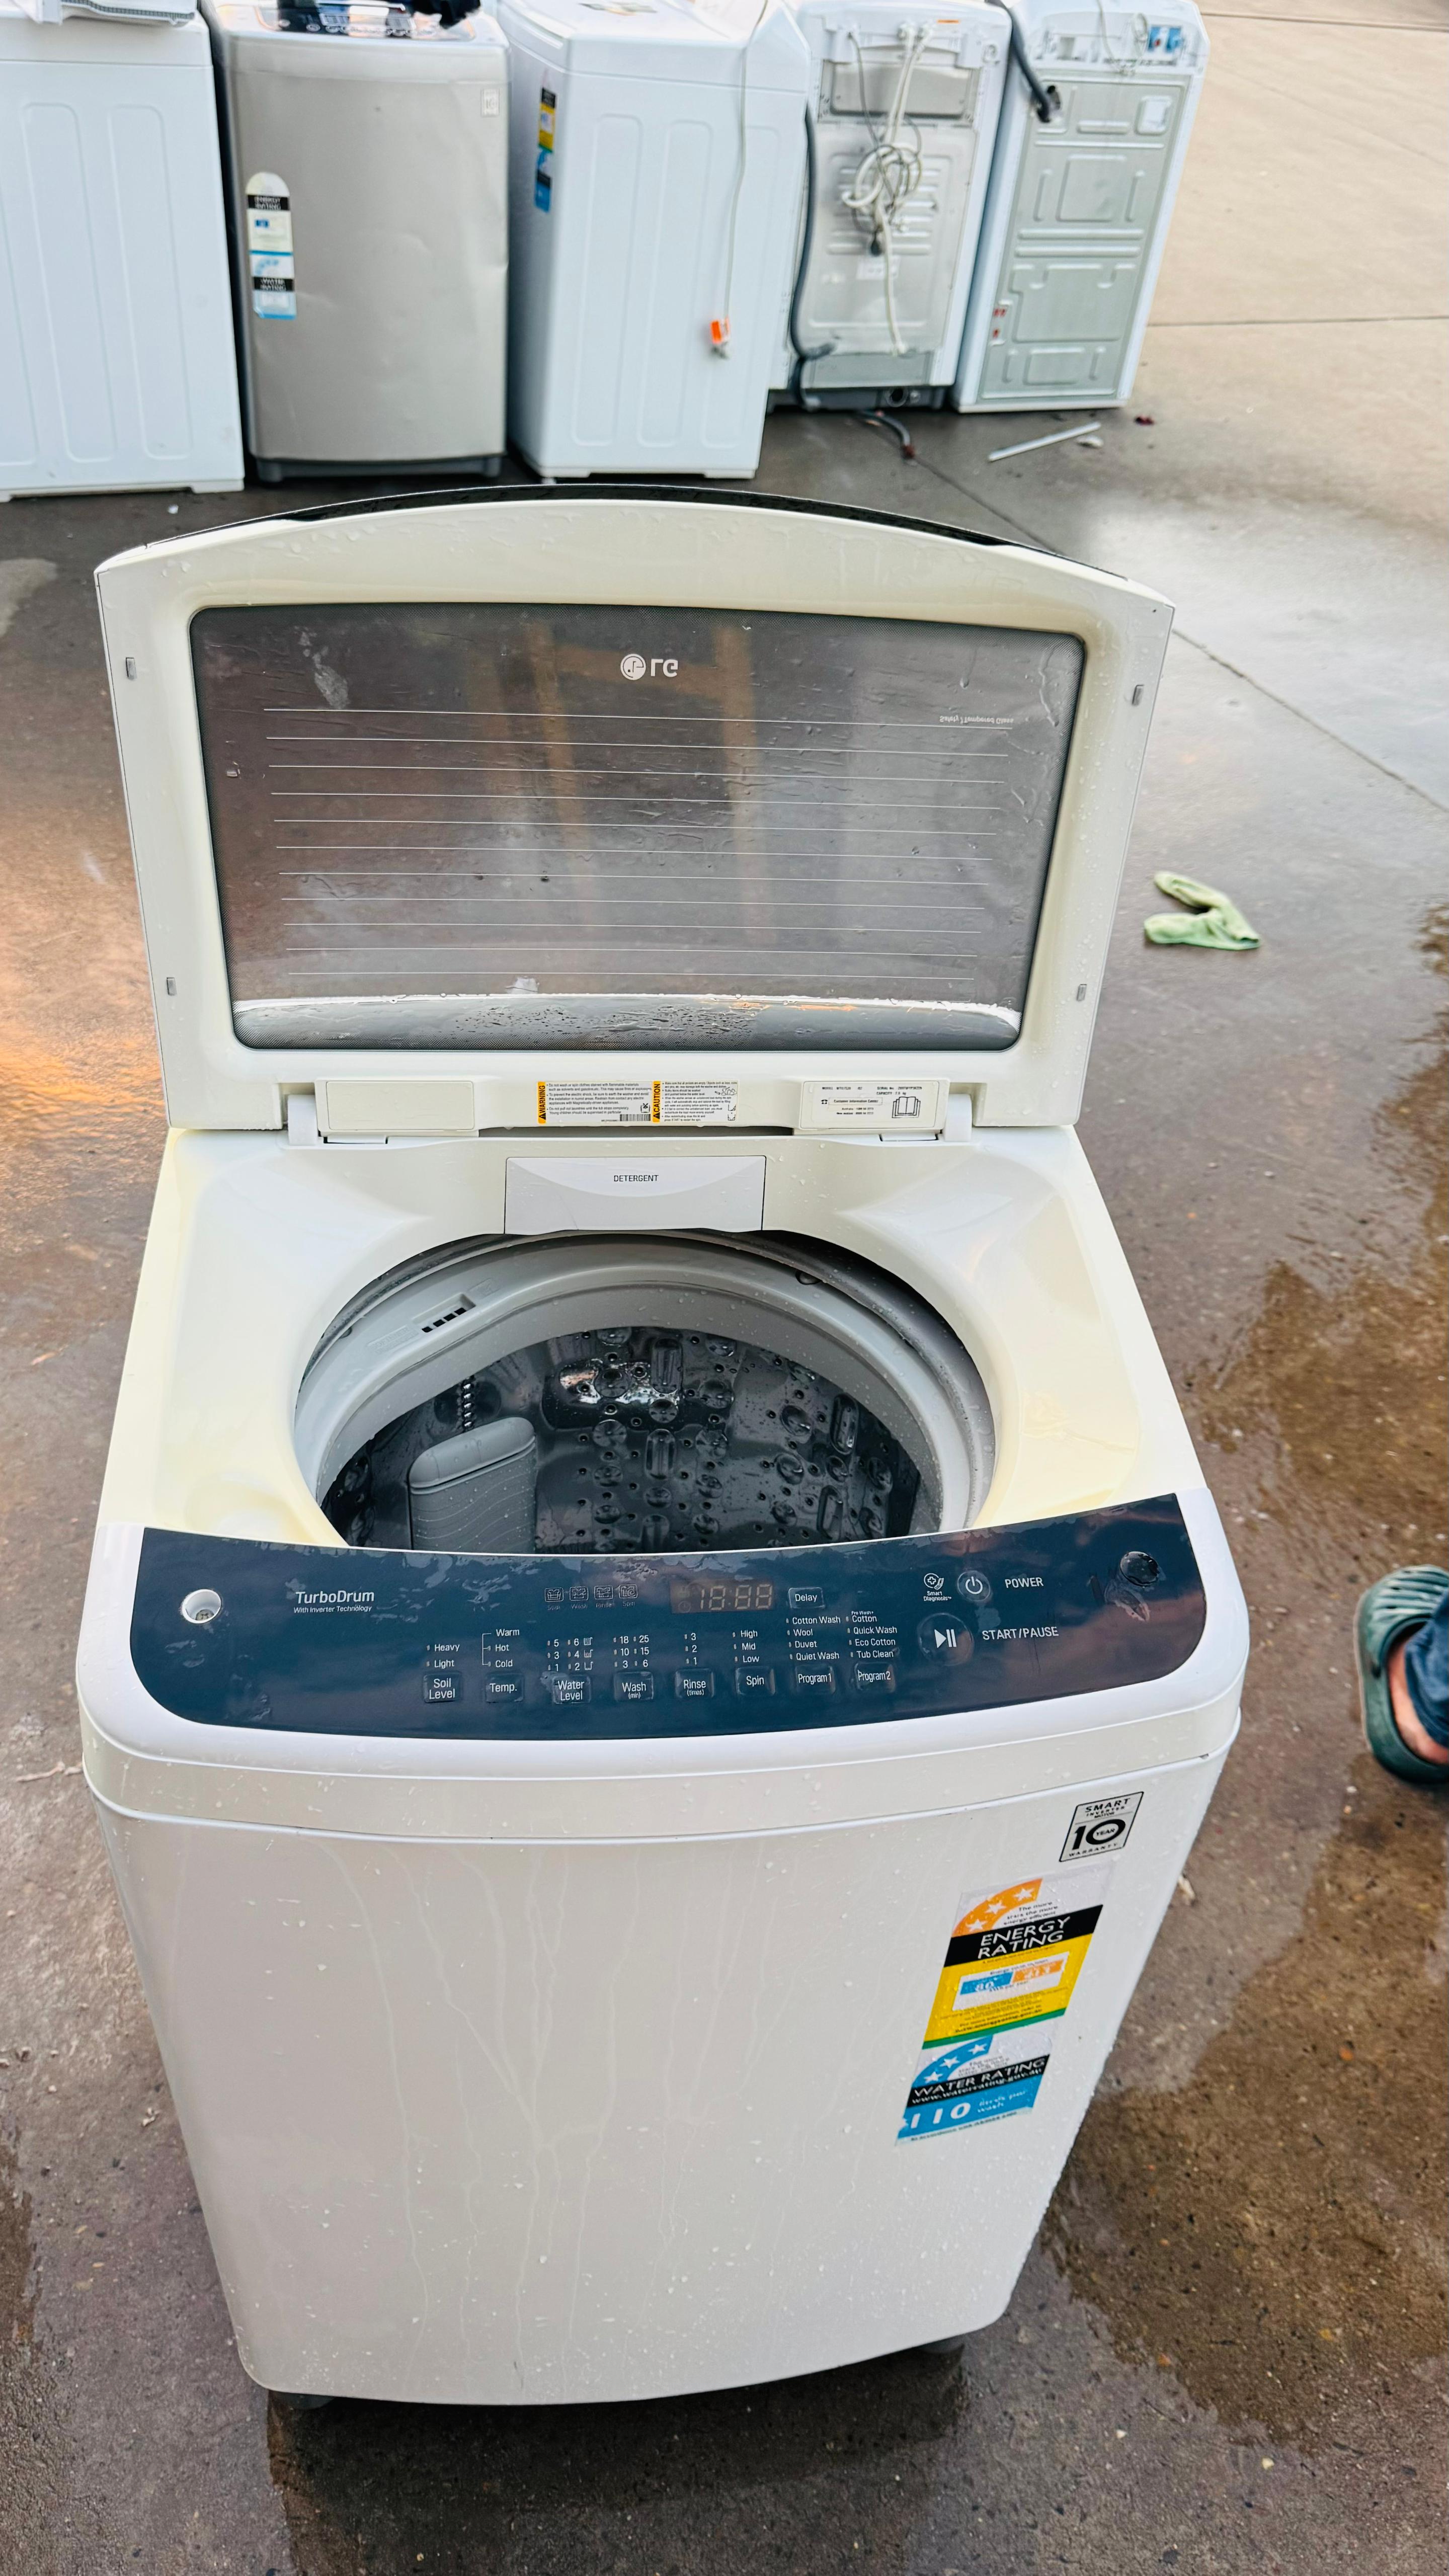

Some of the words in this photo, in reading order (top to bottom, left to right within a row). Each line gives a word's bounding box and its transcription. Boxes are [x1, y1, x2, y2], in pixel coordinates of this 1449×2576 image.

[1005, 1577, 1043, 1588] POWER
[295, 1590, 374, 1603] TurboDrum
[795, 1594, 817, 1602] Delay
[852, 1615, 877, 1623] Cotton
[496, 1629, 520, 1637] Warm
[741, 1630, 758, 1639] High
[793, 1629, 813, 1637] Wool
[853, 1627, 874, 1635] Quick
[875, 1626, 897, 1634] Wash
[982, 1626, 1059, 1640] START/PAUSE
[620, 1636, 629, 1644] 18
[795, 1640, 817, 1648] Duvet
[434, 1644, 460, 1652] Heavy
[620, 1648, 629, 1656] 10
[640, 1647, 650, 1655] 15
[692, 1645, 697, 1653] 2
[796, 1653, 817, 1661] Quiet
[856, 1650, 871, 1658] Tub
[872, 1650, 894, 1658] Clean
[434, 1660, 455, 1669] Light
[495, 1659, 513, 1668] Cold
[693, 1657, 697, 1665] 1
[434, 1678, 451, 1688] Soil
[557, 1680, 585, 1690] Water
[684, 1679, 706, 1689] Rinse
[746, 1675, 764, 1686] Spin
[490, 1683, 517, 1694] Temp.
[622, 1682, 647, 1693] Wash
[429, 1688, 455, 1700] Level
[560, 1690, 583, 1701] Level
[1085, 1798, 1131, 1813] SMART
[1086, 1806, 1125, 1817] INVERTER
[1072, 1819, 1125, 1850] 10
[1096, 1828, 1115, 1836] YEAR
[1069, 1842, 1118, 1857] WARRANTY
[980, 1916, 1071, 1947] ENERGY
[978, 1930, 1064, 1959] RATING
[914, 2076, 975, 2097] WATER
[981, 2057, 1045, 2081] RATING
[911, 2102, 971, 2129] 110
